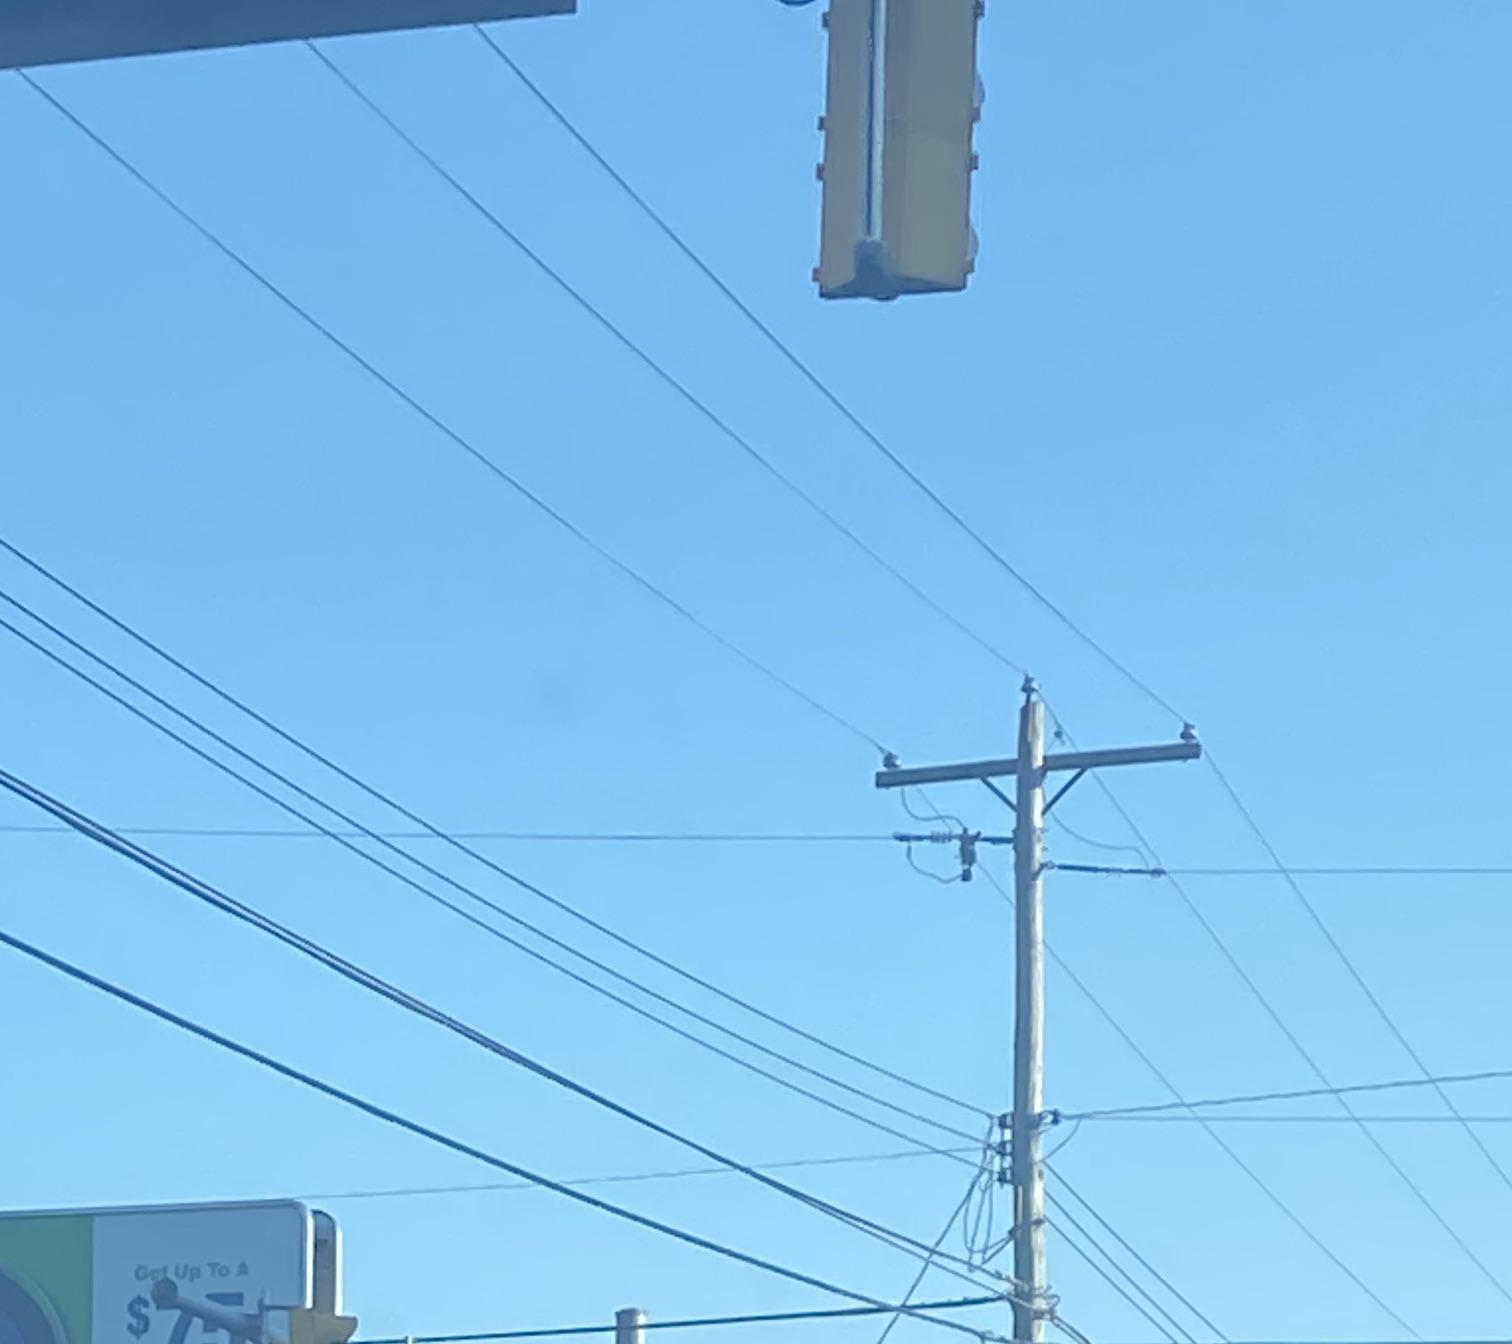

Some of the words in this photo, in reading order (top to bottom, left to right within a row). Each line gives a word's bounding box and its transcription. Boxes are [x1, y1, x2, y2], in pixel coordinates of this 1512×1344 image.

[134, 1264, 168, 1281] Get
[174, 1264, 201, 1281] Up
[207, 1262, 230, 1277] To
[236, 1261, 249, 1277] A
